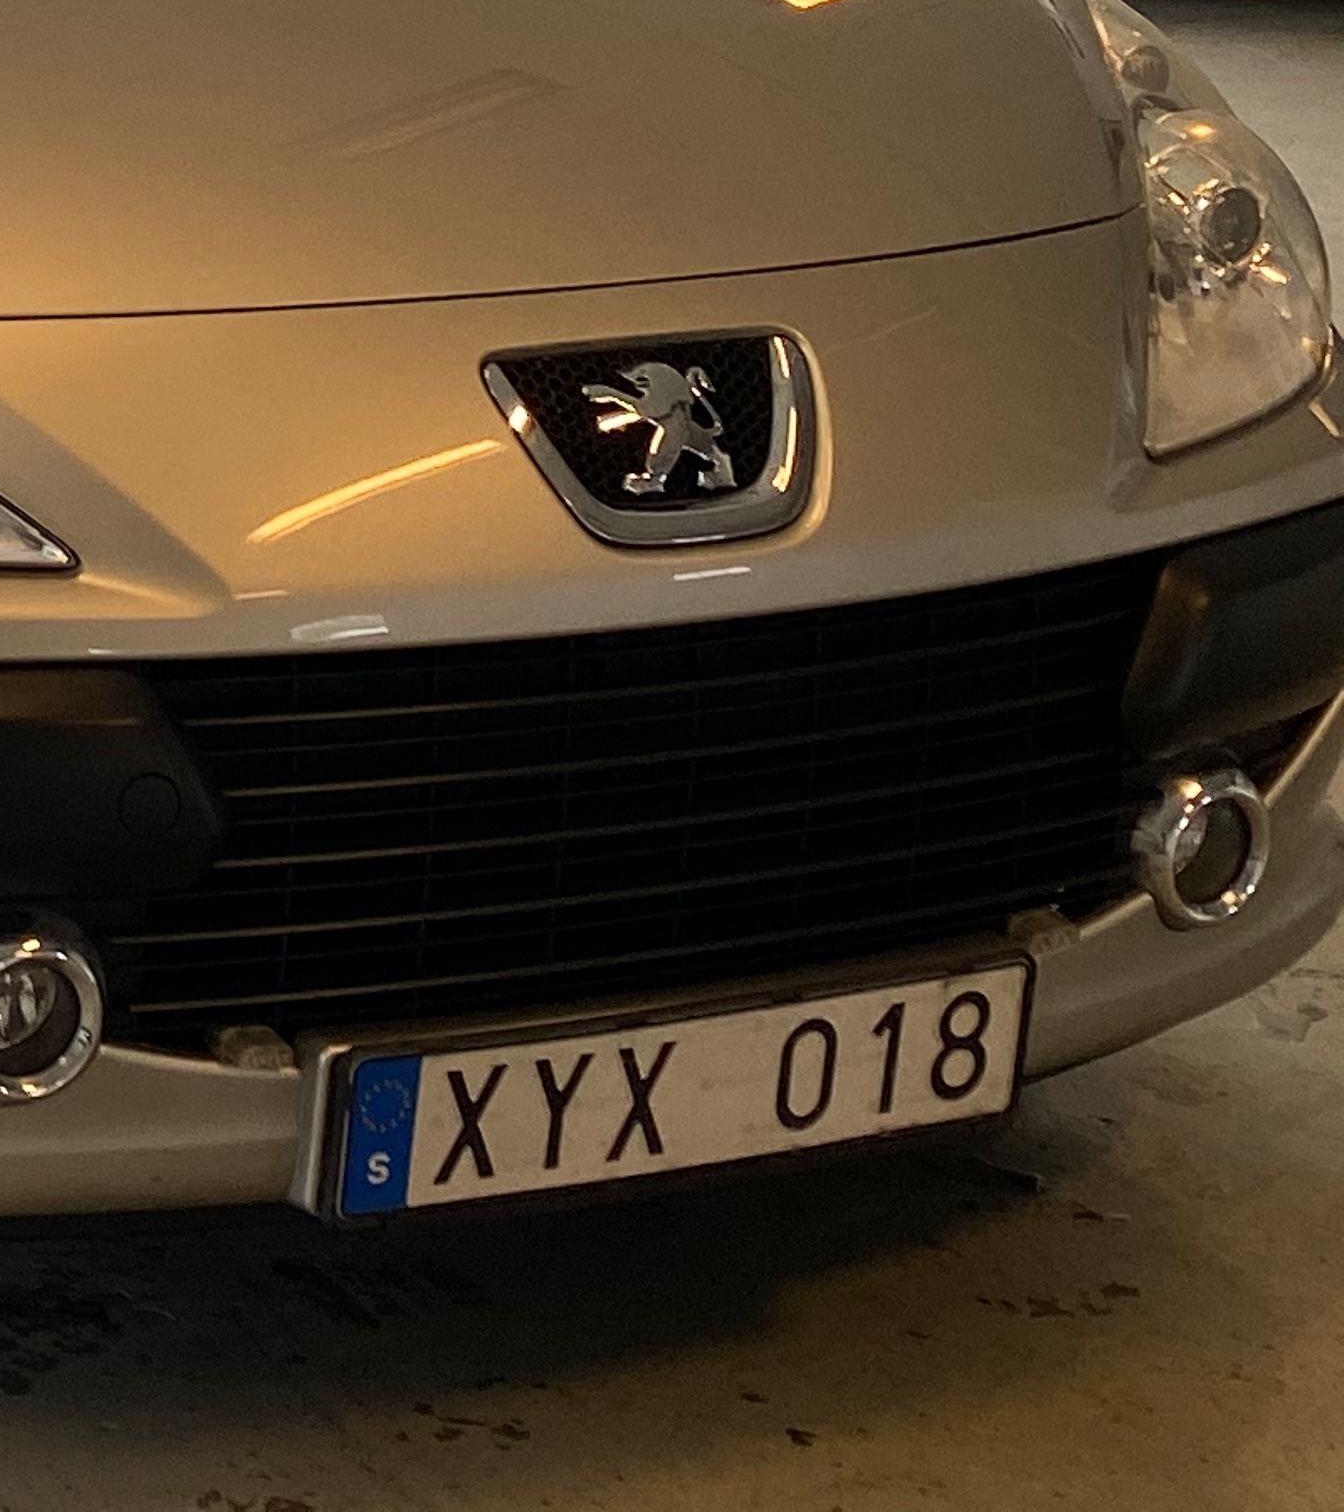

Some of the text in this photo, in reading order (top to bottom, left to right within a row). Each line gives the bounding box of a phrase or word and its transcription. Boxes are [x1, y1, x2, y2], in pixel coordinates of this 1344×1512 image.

[433, 990, 991, 1185] XYX 018
[367, 1153, 391, 1185] S
